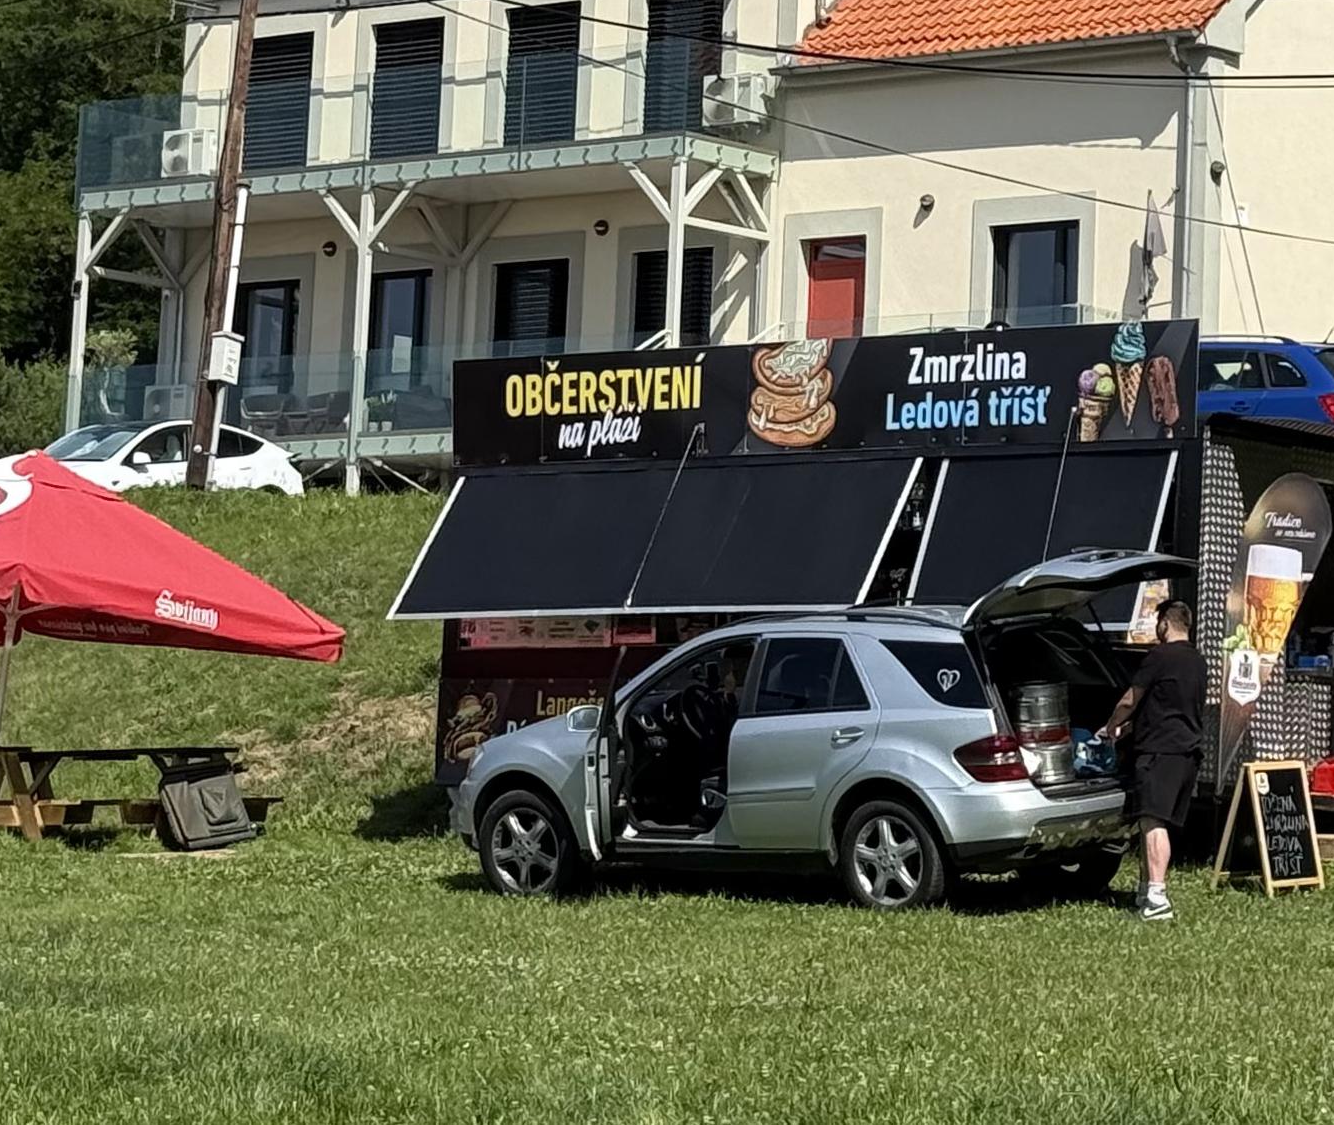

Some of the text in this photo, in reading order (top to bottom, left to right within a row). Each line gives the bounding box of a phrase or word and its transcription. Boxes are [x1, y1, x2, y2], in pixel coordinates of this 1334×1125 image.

[505, 352, 707, 417] OBČERSTVENÍ
[908, 343, 1027, 385] Zmrzlina
[557, 403, 644, 457] na pláži
[885, 385, 1052, 430] Ledová tříšť
[154, 589, 218, 631] Svijany
